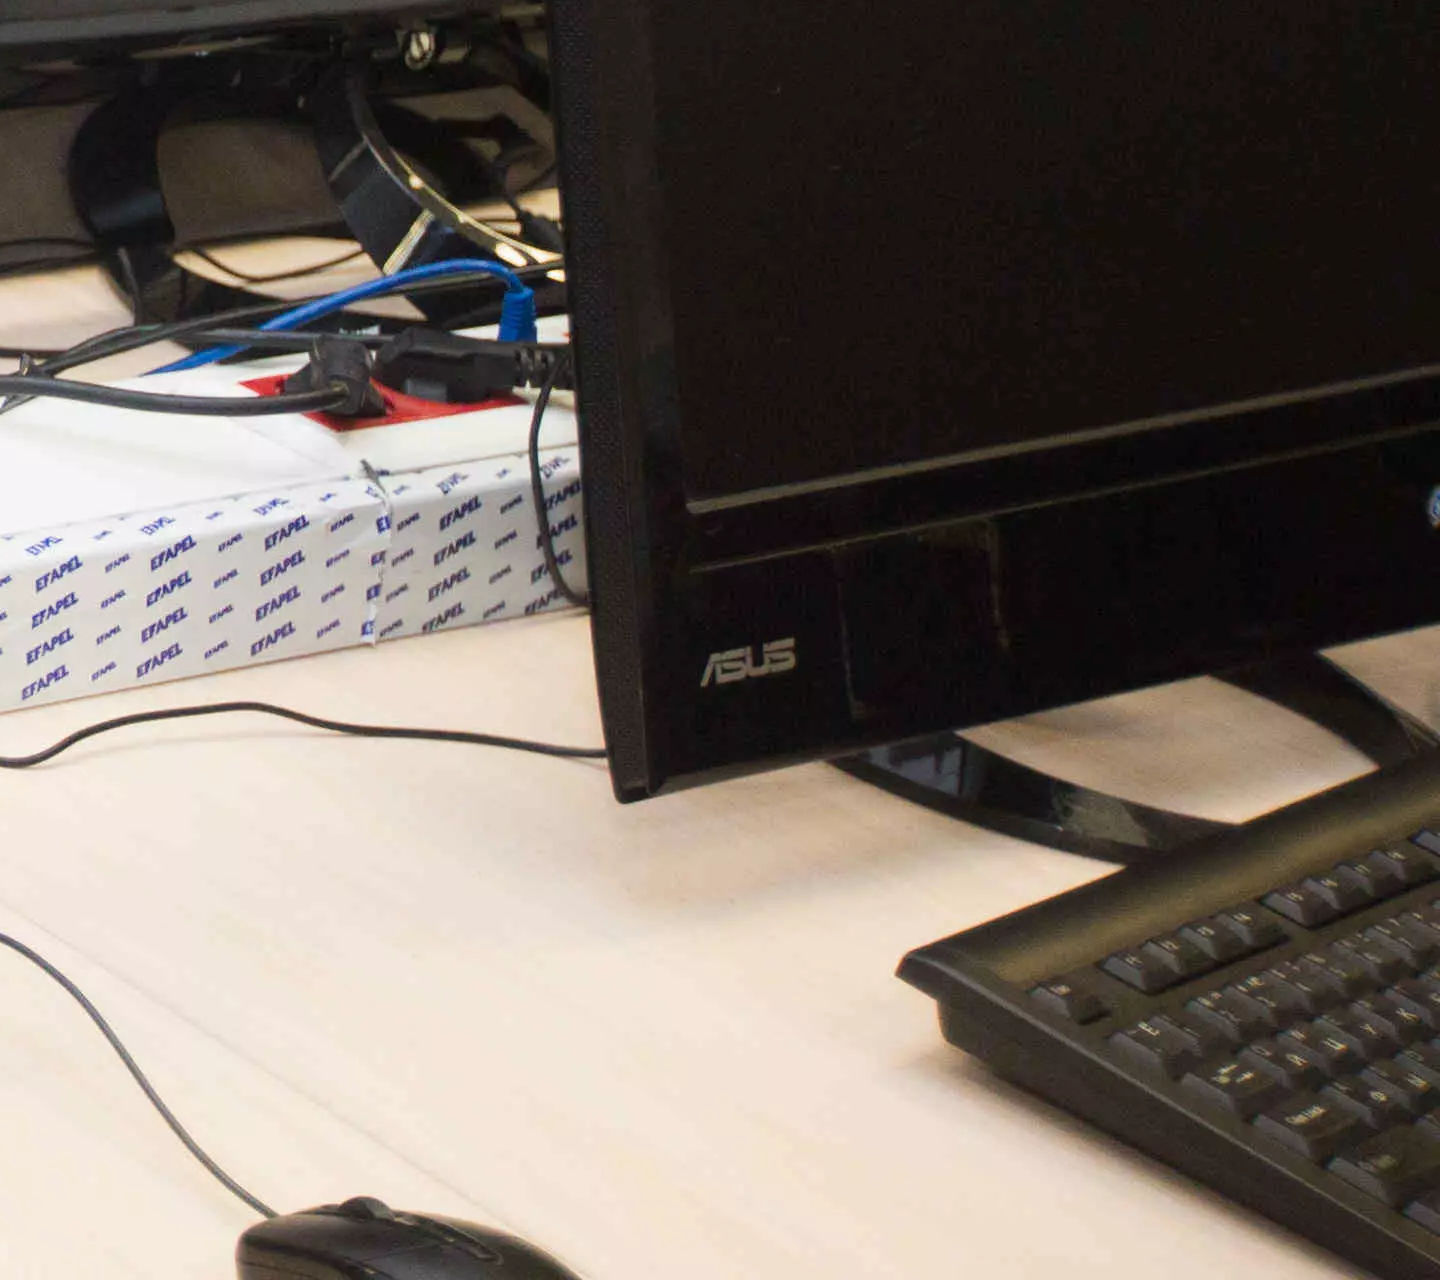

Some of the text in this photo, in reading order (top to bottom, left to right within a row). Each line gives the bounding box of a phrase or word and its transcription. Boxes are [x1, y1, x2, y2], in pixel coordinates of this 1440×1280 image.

[439, 494, 483, 531] EFAPEL
[265, 514, 311, 551] EFAPEL
[433, 530, 477, 566] EFAPEL
[151, 535, 198, 572] EFAPEL
[260, 549, 306, 586] EFAPEL
[35, 555, 84, 592] EFAPEL
[146, 570, 193, 607] EFAPEL
[428, 566, 471, 602] EFAPEL
[31, 592, 79, 629] EFAPEL
[255, 585, 301, 621] EFAPEL
[422, 601, 466, 634] EFAPEL
[141, 607, 188, 643] EFAPEL
[250, 621, 296, 656] EFAPEL
[26, 628, 75, 665] EFAPEL
[136, 643, 183, 678] EFAPEL
[700, 637, 796, 688] ASUS
[21, 664, 70, 700] EFAPEL
